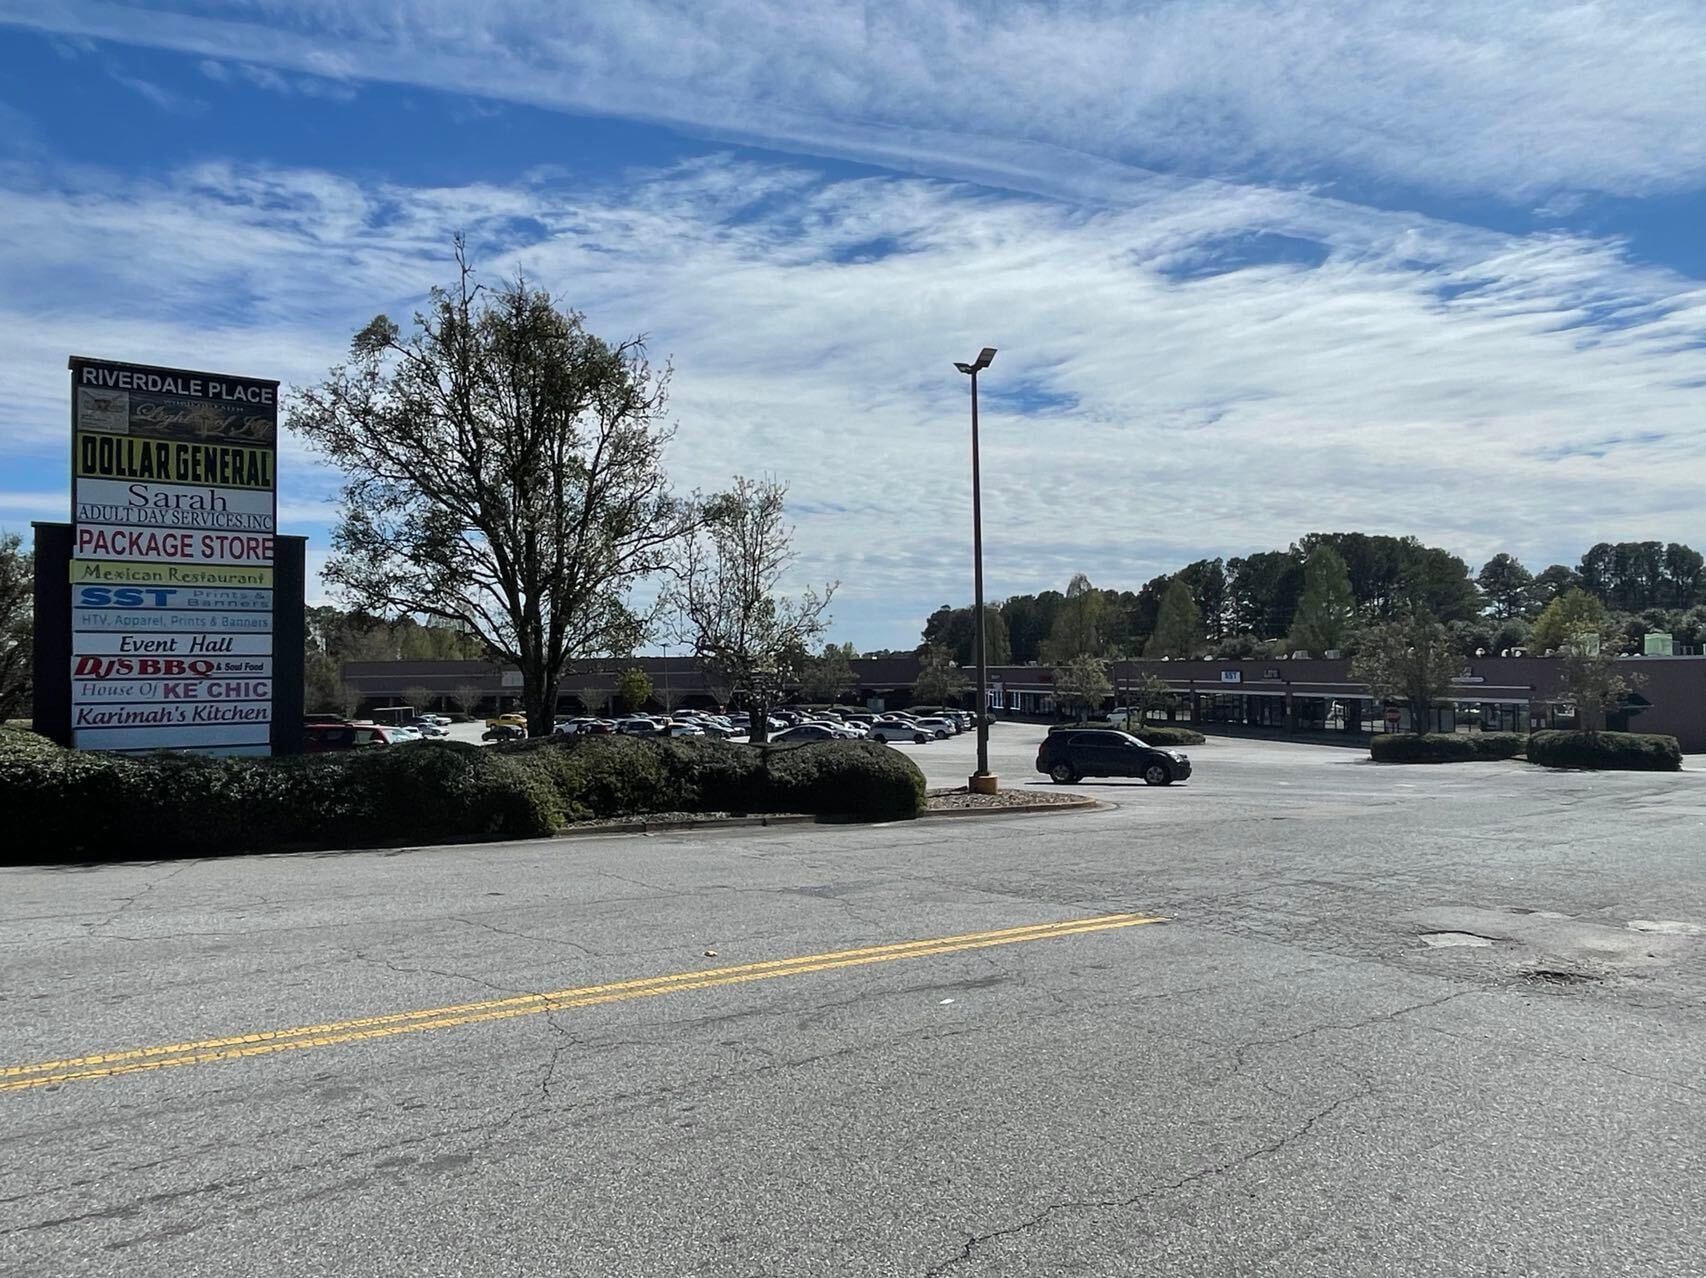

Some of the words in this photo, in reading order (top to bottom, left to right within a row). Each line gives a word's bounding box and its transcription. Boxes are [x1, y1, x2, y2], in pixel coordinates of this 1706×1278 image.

[82, 367, 203, 397] RIVERDALE
[208, 382, 273, 404] PLACE
[82, 435, 171, 481] DOLLAR
[175, 444, 271, 487] GENERAL
[128, 484, 227, 512] Sarah
[78, 505, 133, 523] ADULT
[137, 508, 169, 524] DAY
[79, 529, 194, 559] PACKAGE
[201, 534, 274, 560] STORE
[82, 564, 162, 582] Mexican
[168, 568, 265, 585] Restaurant
[80, 587, 177, 607] SST
[187, 598, 269, 608] Banners
[192, 590, 248, 600] Prints
[254, 592, 265, 600] &
[81, 614, 111, 627] HTV,
[114, 614, 165, 629] Apparel,
[170, 615, 206, 626] Prints
[209, 616, 217, 626] &
[222, 616, 269, 628] Banners
[119, 636, 177, 653] Event
[189, 634, 234, 653] Hall
[137, 659, 215, 678] BBQ
[215, 663, 222, 671] &
[224, 662, 243, 671] Soul
[244, 662, 264, 671] Food
[80, 683, 134, 696] House
[139, 682, 159, 700] Of
[207, 682, 269, 698] CHIC
[76, 707, 187, 725] Karimah's
[191, 704, 268, 722] Kitchen
